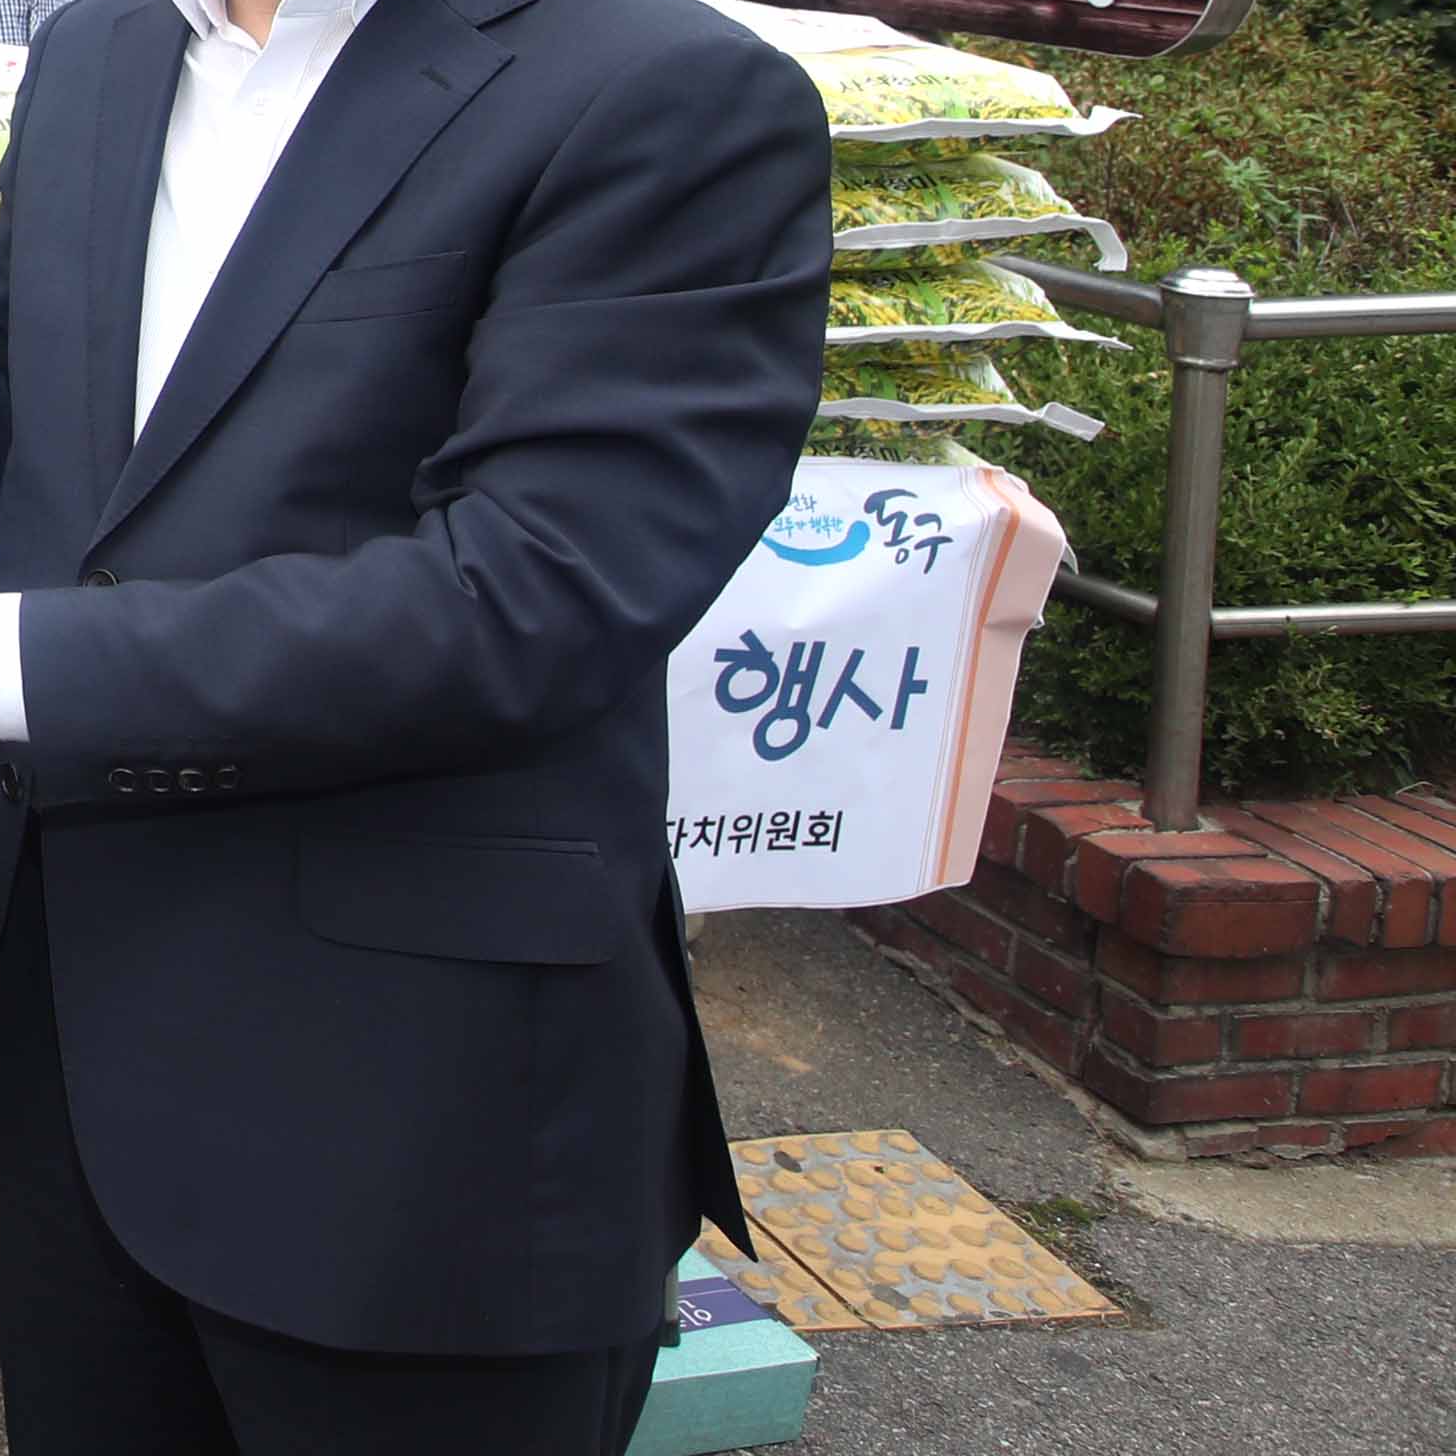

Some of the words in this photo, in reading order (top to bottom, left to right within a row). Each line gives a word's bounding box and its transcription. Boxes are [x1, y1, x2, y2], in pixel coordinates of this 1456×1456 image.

[808, 515, 844, 539] 행복한
[863, 488, 953, 575] 동구
[714, 629, 928, 762] 행사
[666, 810, 843, 859] 자치위원회
